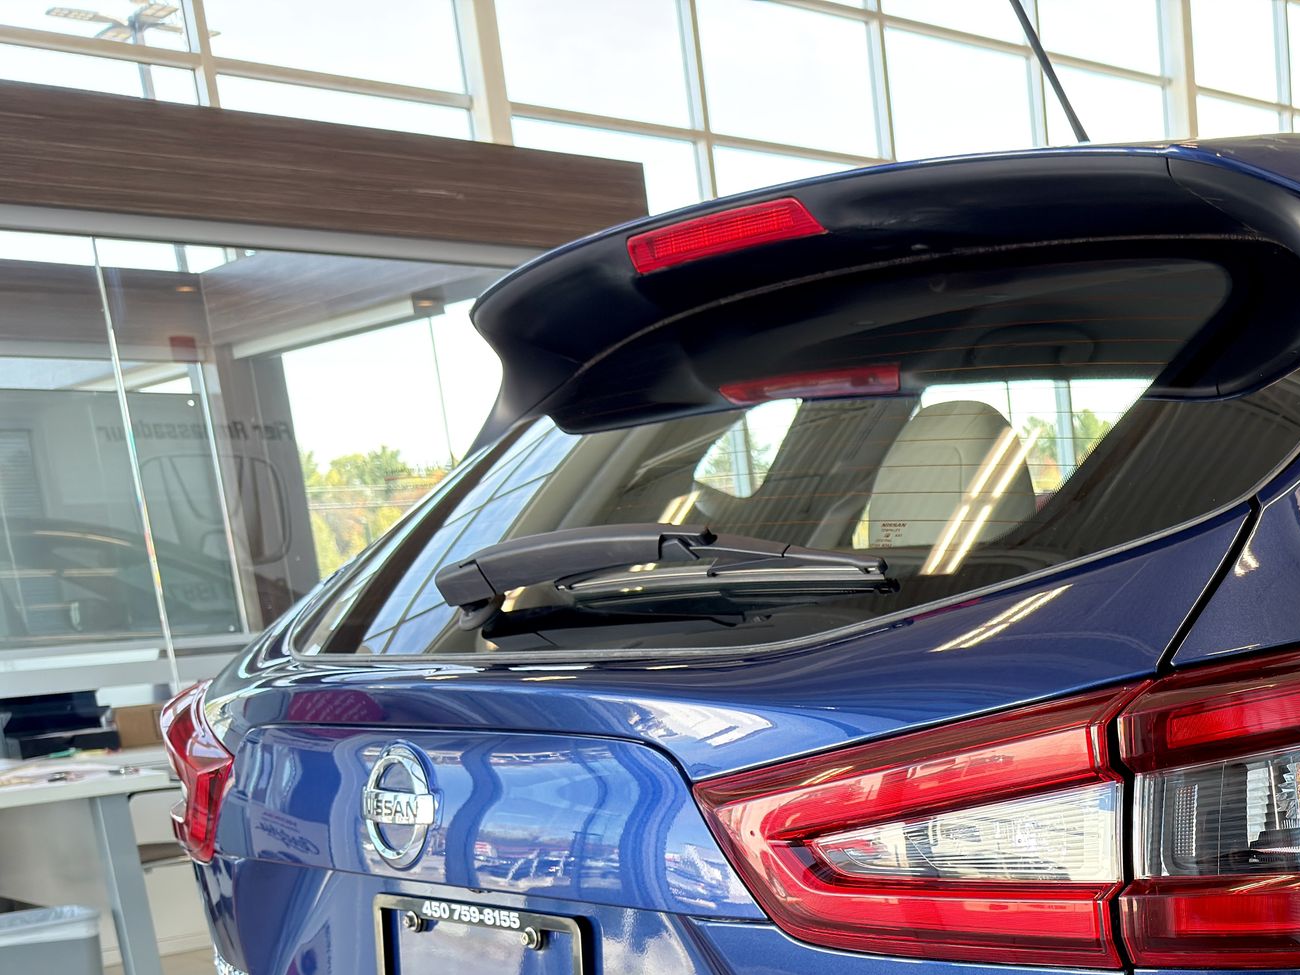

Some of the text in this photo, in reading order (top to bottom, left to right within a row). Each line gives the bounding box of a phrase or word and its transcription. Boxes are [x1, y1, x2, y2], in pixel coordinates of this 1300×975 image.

[366, 793, 419, 818] NISSAN
[422, 900, 520, 929] 450 759-8155
